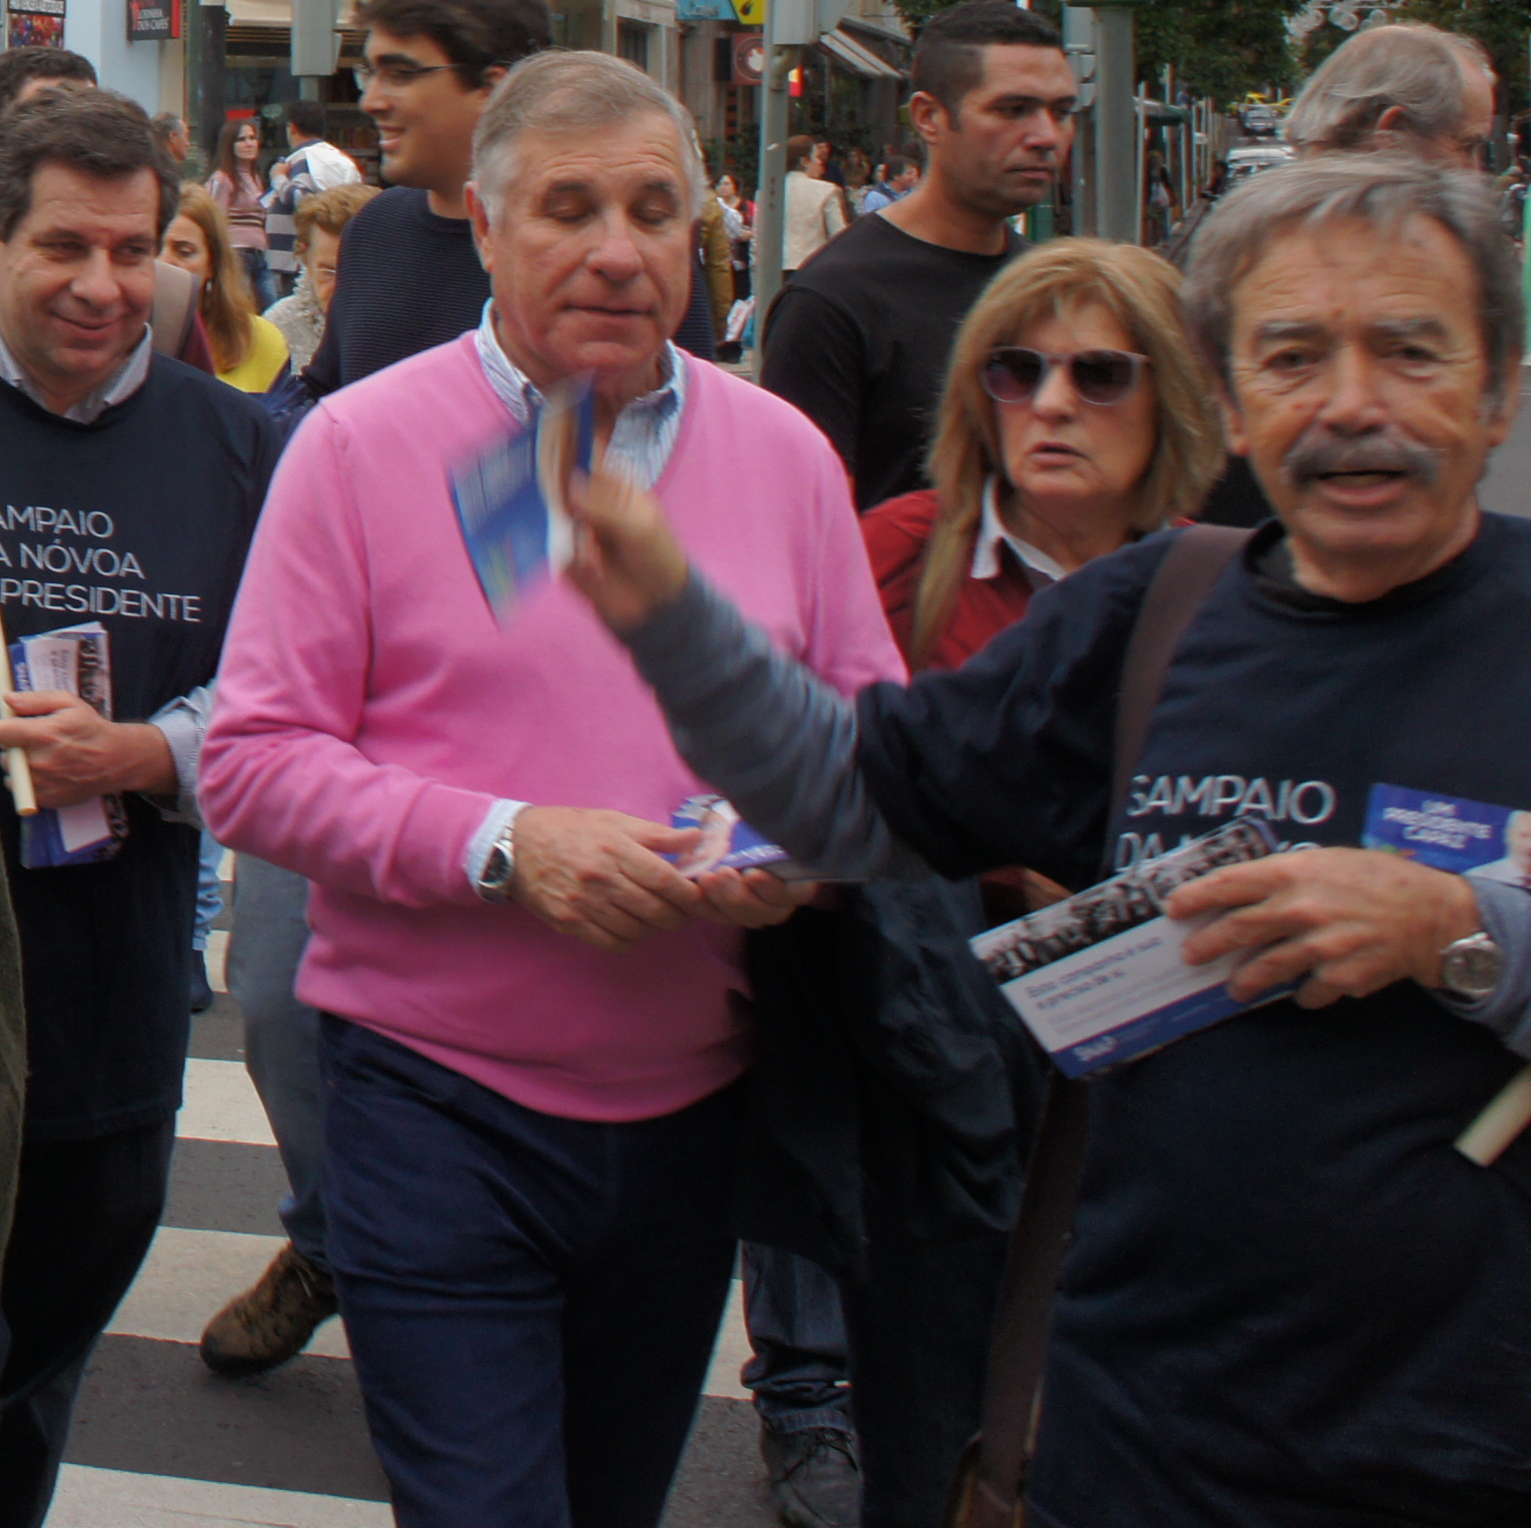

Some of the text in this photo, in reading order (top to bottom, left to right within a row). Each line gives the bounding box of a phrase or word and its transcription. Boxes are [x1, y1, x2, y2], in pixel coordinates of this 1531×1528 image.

[19, 538, 146, 580] NÓVOA
[0, 577, 202, 622] PRESIDENTE
[1126, 774, 1338, 824] SAMPAIO
